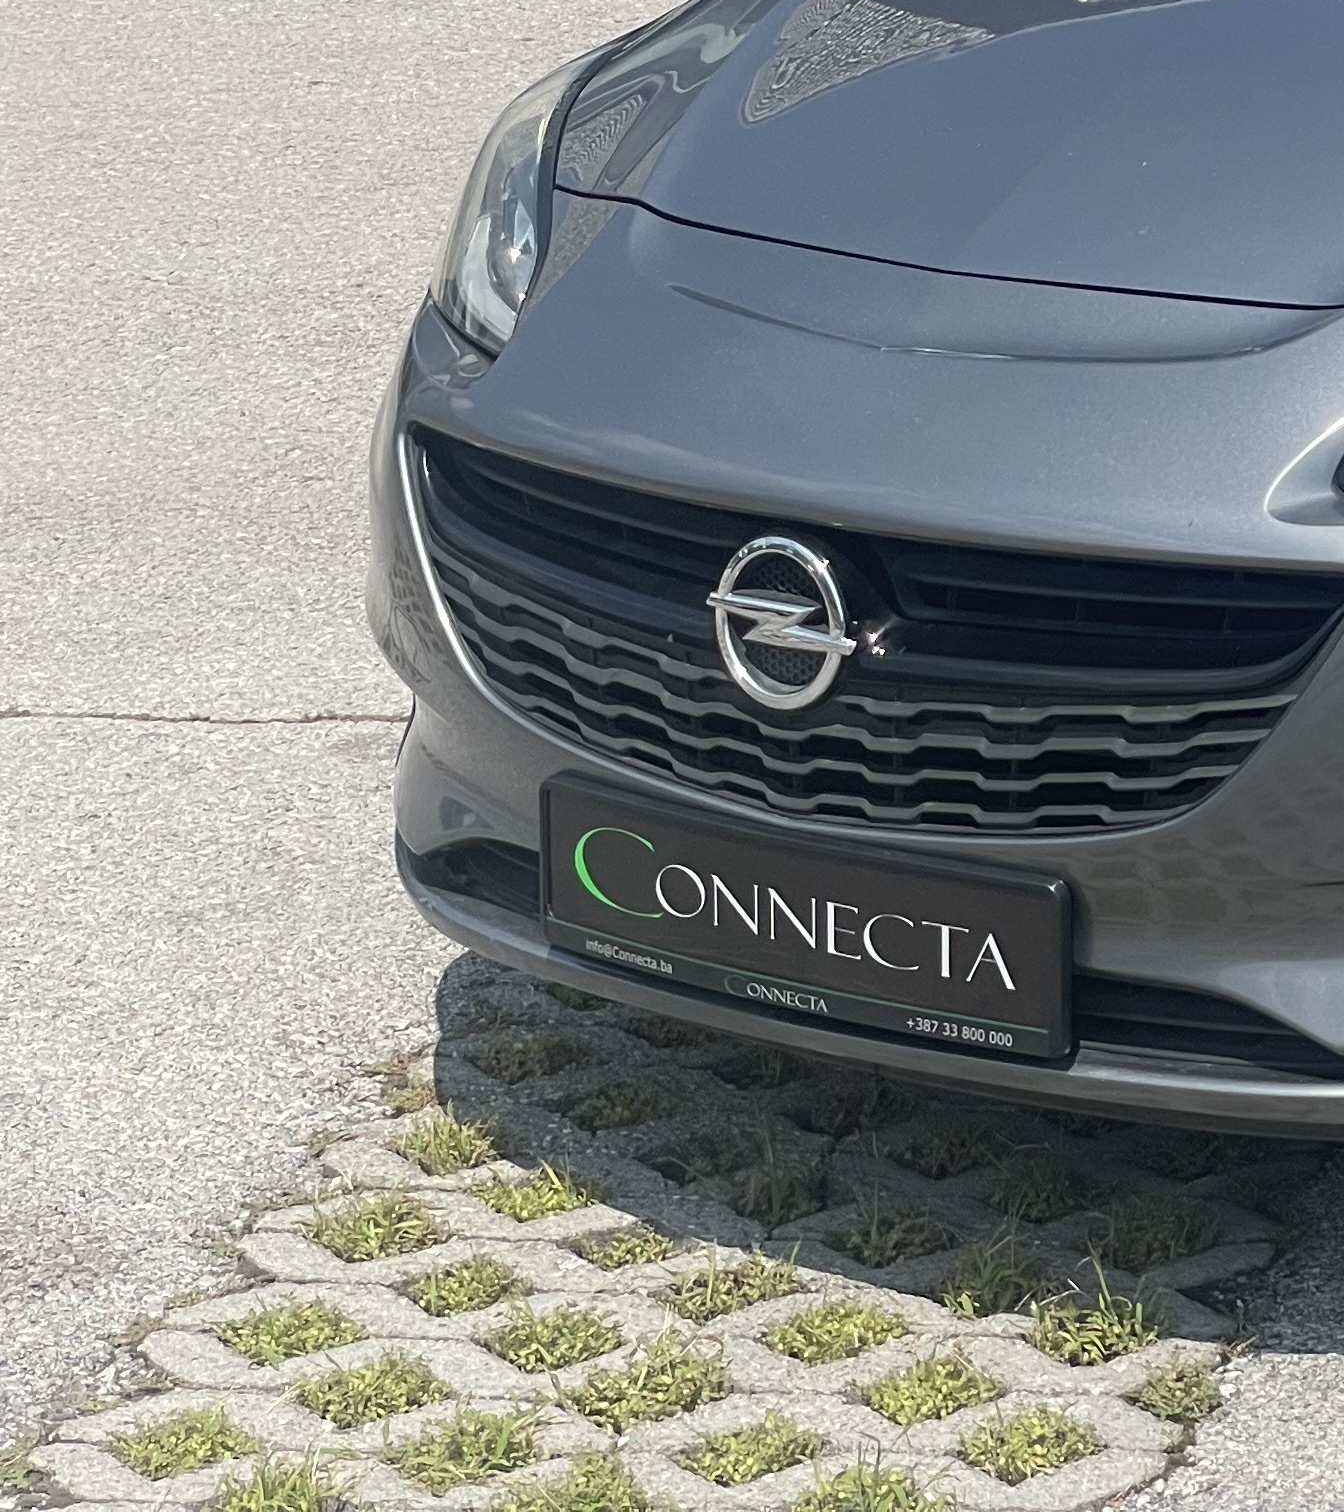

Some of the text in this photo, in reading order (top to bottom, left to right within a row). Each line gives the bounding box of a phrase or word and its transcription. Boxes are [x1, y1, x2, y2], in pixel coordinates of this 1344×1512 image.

[574, 827, 1016, 991] CONNECTA
[585, 938, 674, 975] info@Connecta.ba
[724, 974, 829, 1013] CONNECTA
[906, 1017, 1013, 1047] +387 33 800 000
